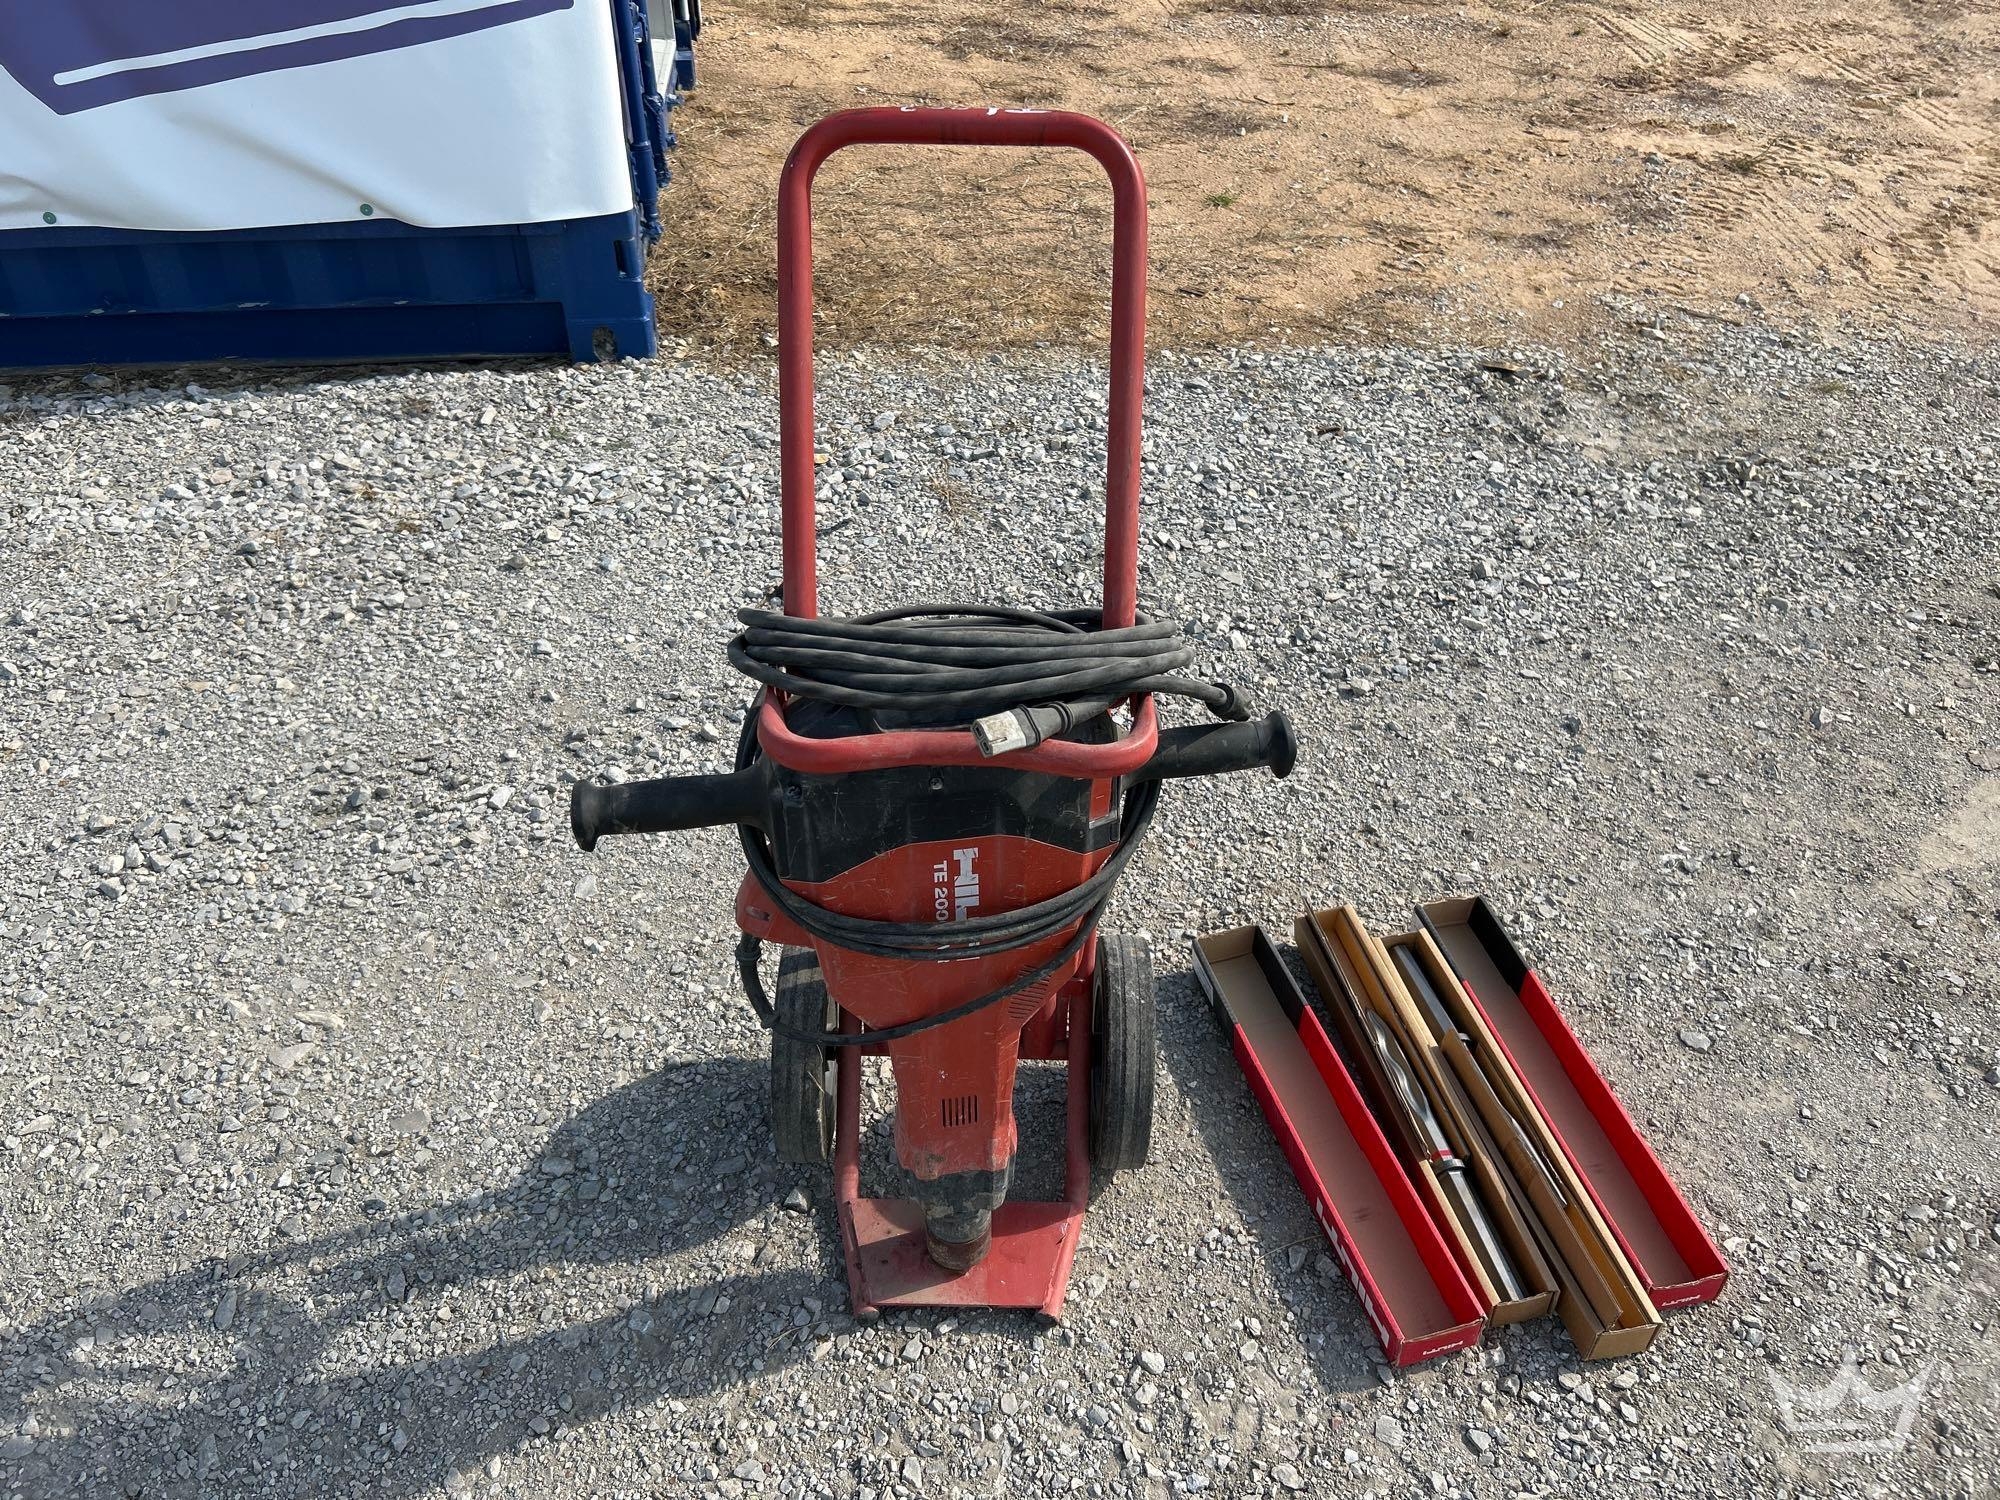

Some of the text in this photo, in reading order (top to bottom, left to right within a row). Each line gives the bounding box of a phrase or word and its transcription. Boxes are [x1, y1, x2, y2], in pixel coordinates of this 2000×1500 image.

[933, 860, 948, 883] TE
[953, 847, 980, 961] HIL
[1315, 1197, 1390, 1348] HILTI
